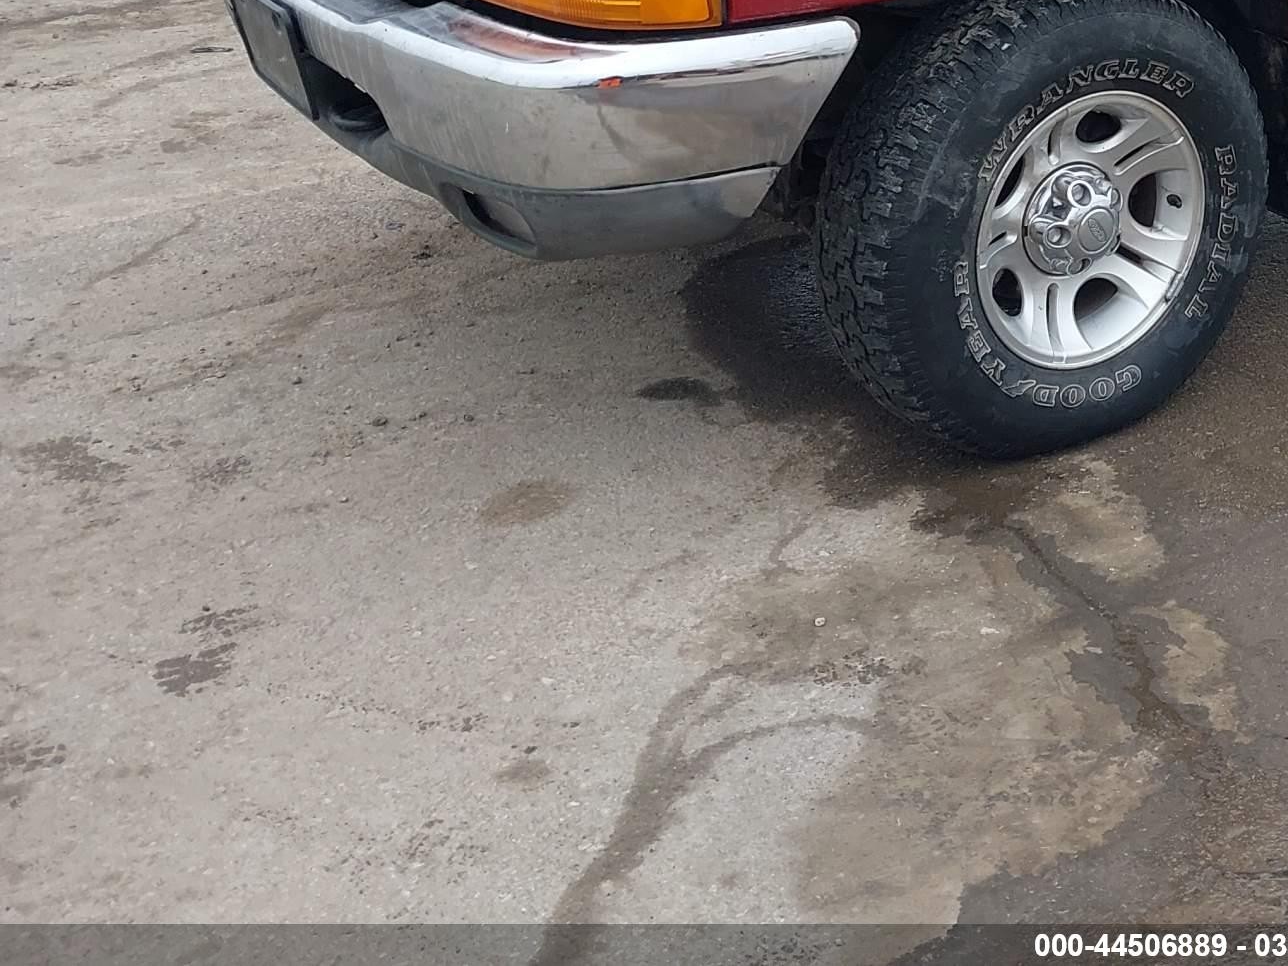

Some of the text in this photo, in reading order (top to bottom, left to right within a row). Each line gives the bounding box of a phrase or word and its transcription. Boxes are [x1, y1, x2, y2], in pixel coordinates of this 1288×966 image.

[978, 58, 1195, 183] WRANGLER
[1185, 145, 1240, 320] RADIAL
[953, 260, 1142, 408] GOODYEAR
